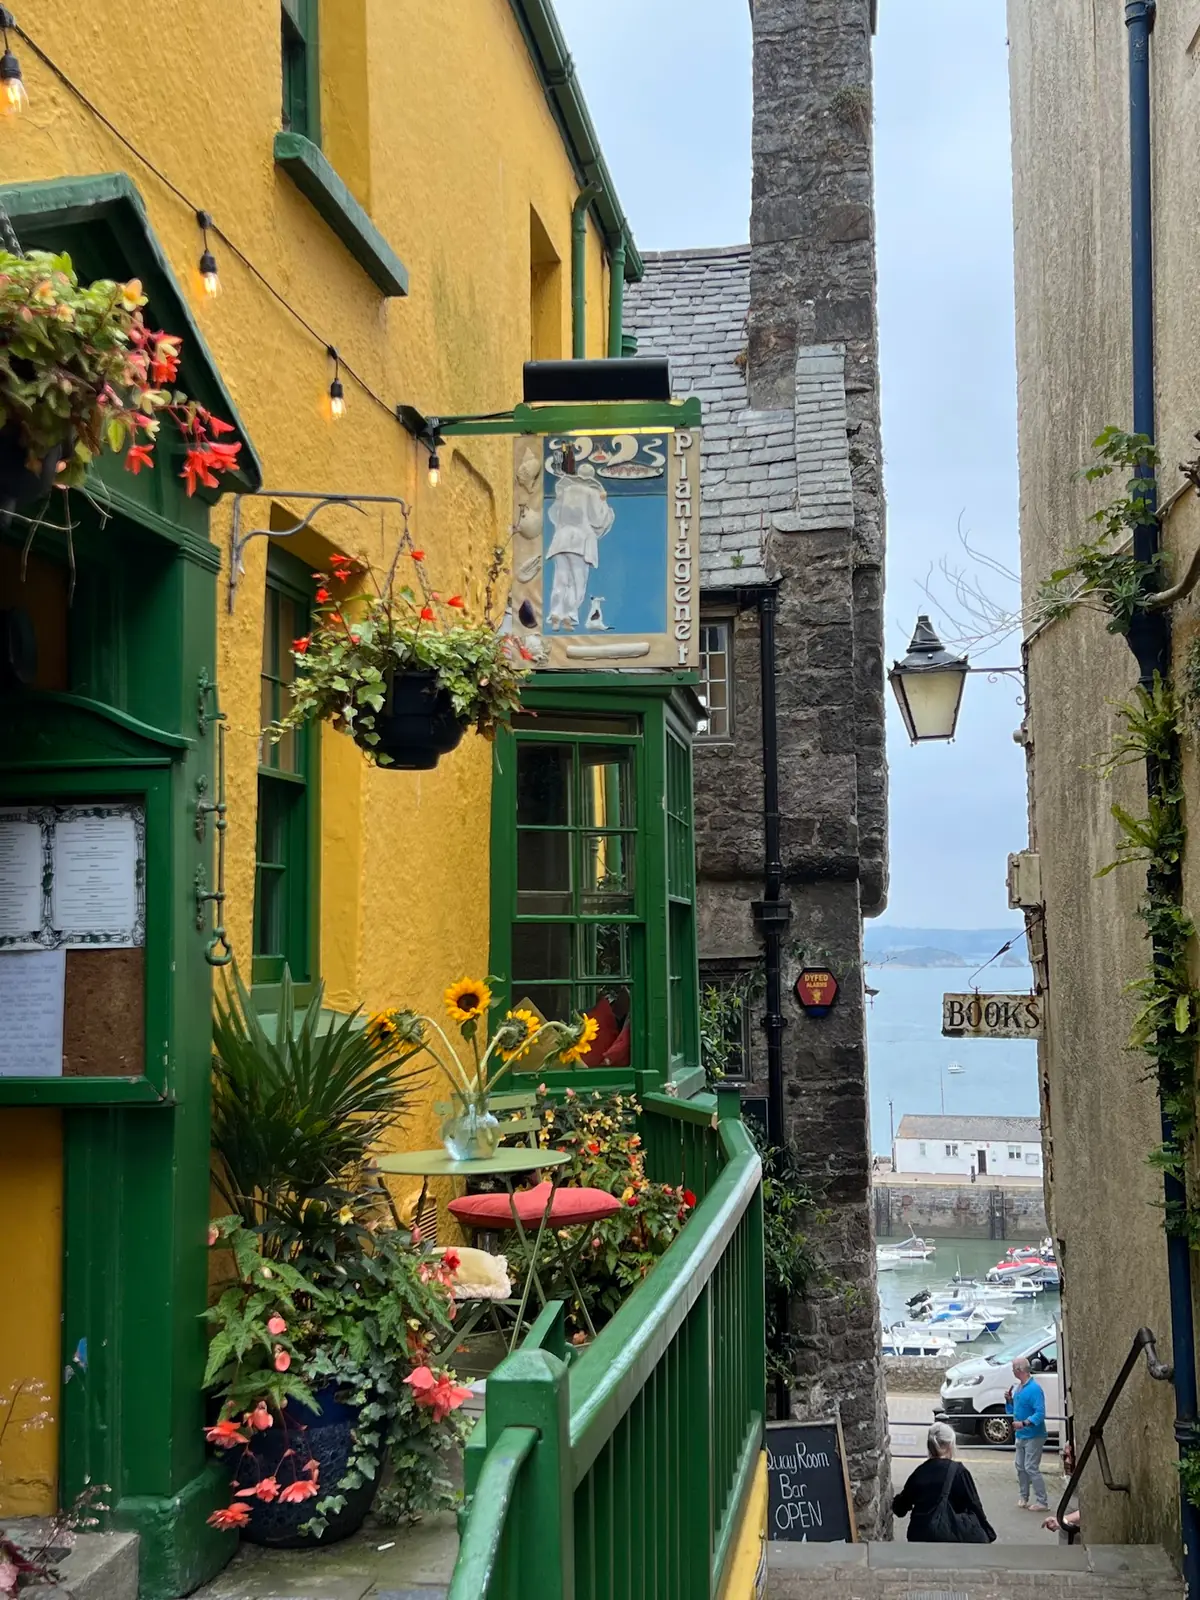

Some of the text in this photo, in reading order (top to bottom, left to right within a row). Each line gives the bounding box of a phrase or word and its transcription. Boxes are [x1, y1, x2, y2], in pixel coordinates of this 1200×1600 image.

[804, 974, 829, 982] DYFED
[948, 1000, 1040, 1029] BOOKS
[795, 1442, 830, 1469] Room
[779, 1473, 808, 1499] Bar
[775, 1500, 823, 1530] OPEN
